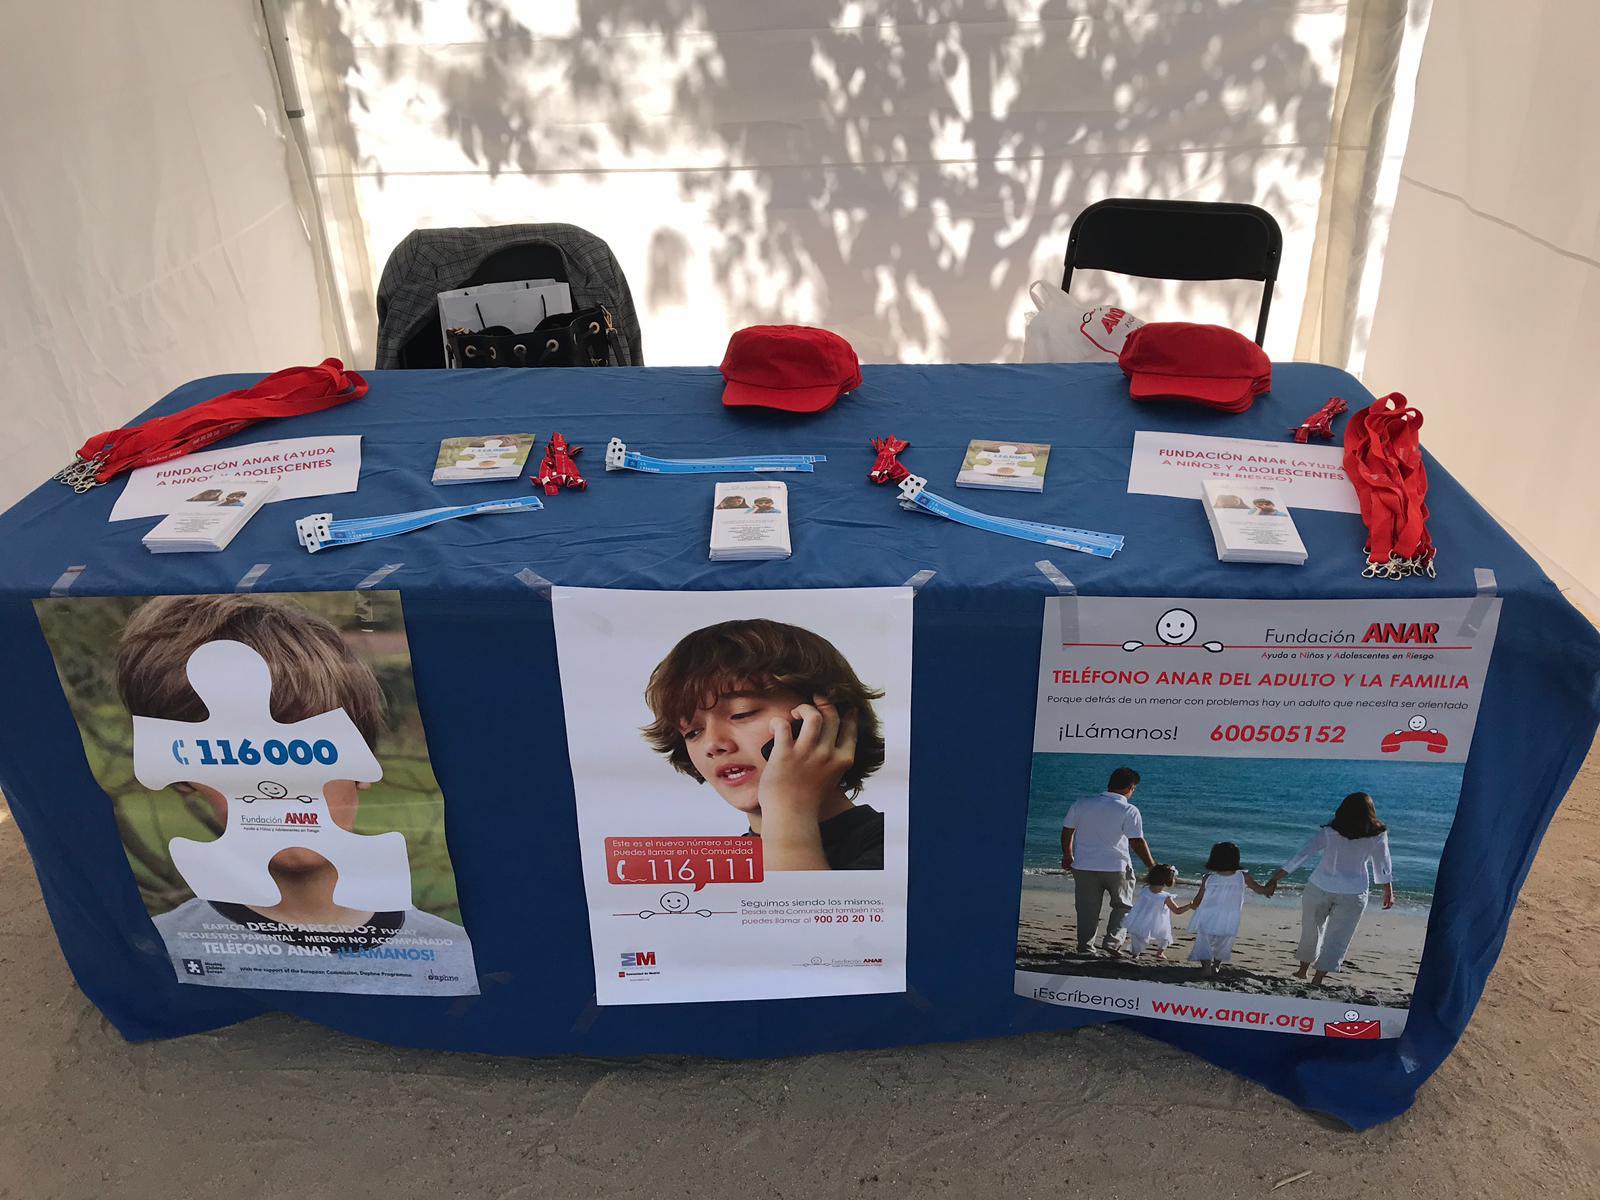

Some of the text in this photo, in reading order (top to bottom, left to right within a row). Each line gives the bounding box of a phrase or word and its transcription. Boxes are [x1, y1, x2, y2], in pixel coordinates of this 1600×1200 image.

[156, 446, 336, 479] FUNDACIÓN ANAR (AYUDA
[1159, 449, 1243, 462] FUNDACIÓN
[1247, 456, 1288, 465] ANAR
[1176, 460, 1222, 470] NIÑOS
[1237, 465, 1345, 481] ADOLESCENTES
[1235, 473, 1293, 484] RIESGO)
[1265, 622, 1440, 644] Fundación ANAR
[1261, 651, 1289, 660] Ayuda
[1300, 651, 1324, 659] Niños
[1333, 651, 1390, 660] Adolescentes
[1406, 652, 1434, 661] Riesgo
[1053, 666, 1470, 689] TELÉFONO ANAR DEL ADULTO Y LA FAMILIA
[1047, 695, 1469, 710] Porque detrás de un menor con problemas hay un adulto que necesita ser orientado
[1058, 723, 1346, 743] ¡LLámanos! 600505152
[195, 738, 339, 766] 116000
[241, 812, 319, 825] Fundación ANAR
[735, 840, 753, 848] que
[613, 848, 646, 857] puedes
[648, 848, 675, 856] llamar
[691, 848, 699, 856] tu
[701, 847, 753, 855] Comunidad
[648, 858, 755, 881] 116 111
[741, 899, 790, 908] Seguimos
[792, 899, 826, 907] siendo
[742, 917, 773, 925] puedes
[814, 915, 833, 924] 900
[836, 915, 849, 923] 20
[852, 915, 865, 923] 20
[869, 914, 884, 923] 10.
[246, 922, 377, 934] DESAPARECIDO?
[240, 933, 295, 942] PARENTAL
[305, 935, 347, 944] MENOR
[348, 936, 368, 944] NO
[371, 936, 454, 946] ACOMPAÑADO
[202, 940, 435, 961] TELÉFONO ANAR ¡LLÁMANOS!
[1033, 987, 1315, 1033] ¡Escríbenos! www.anar.org
